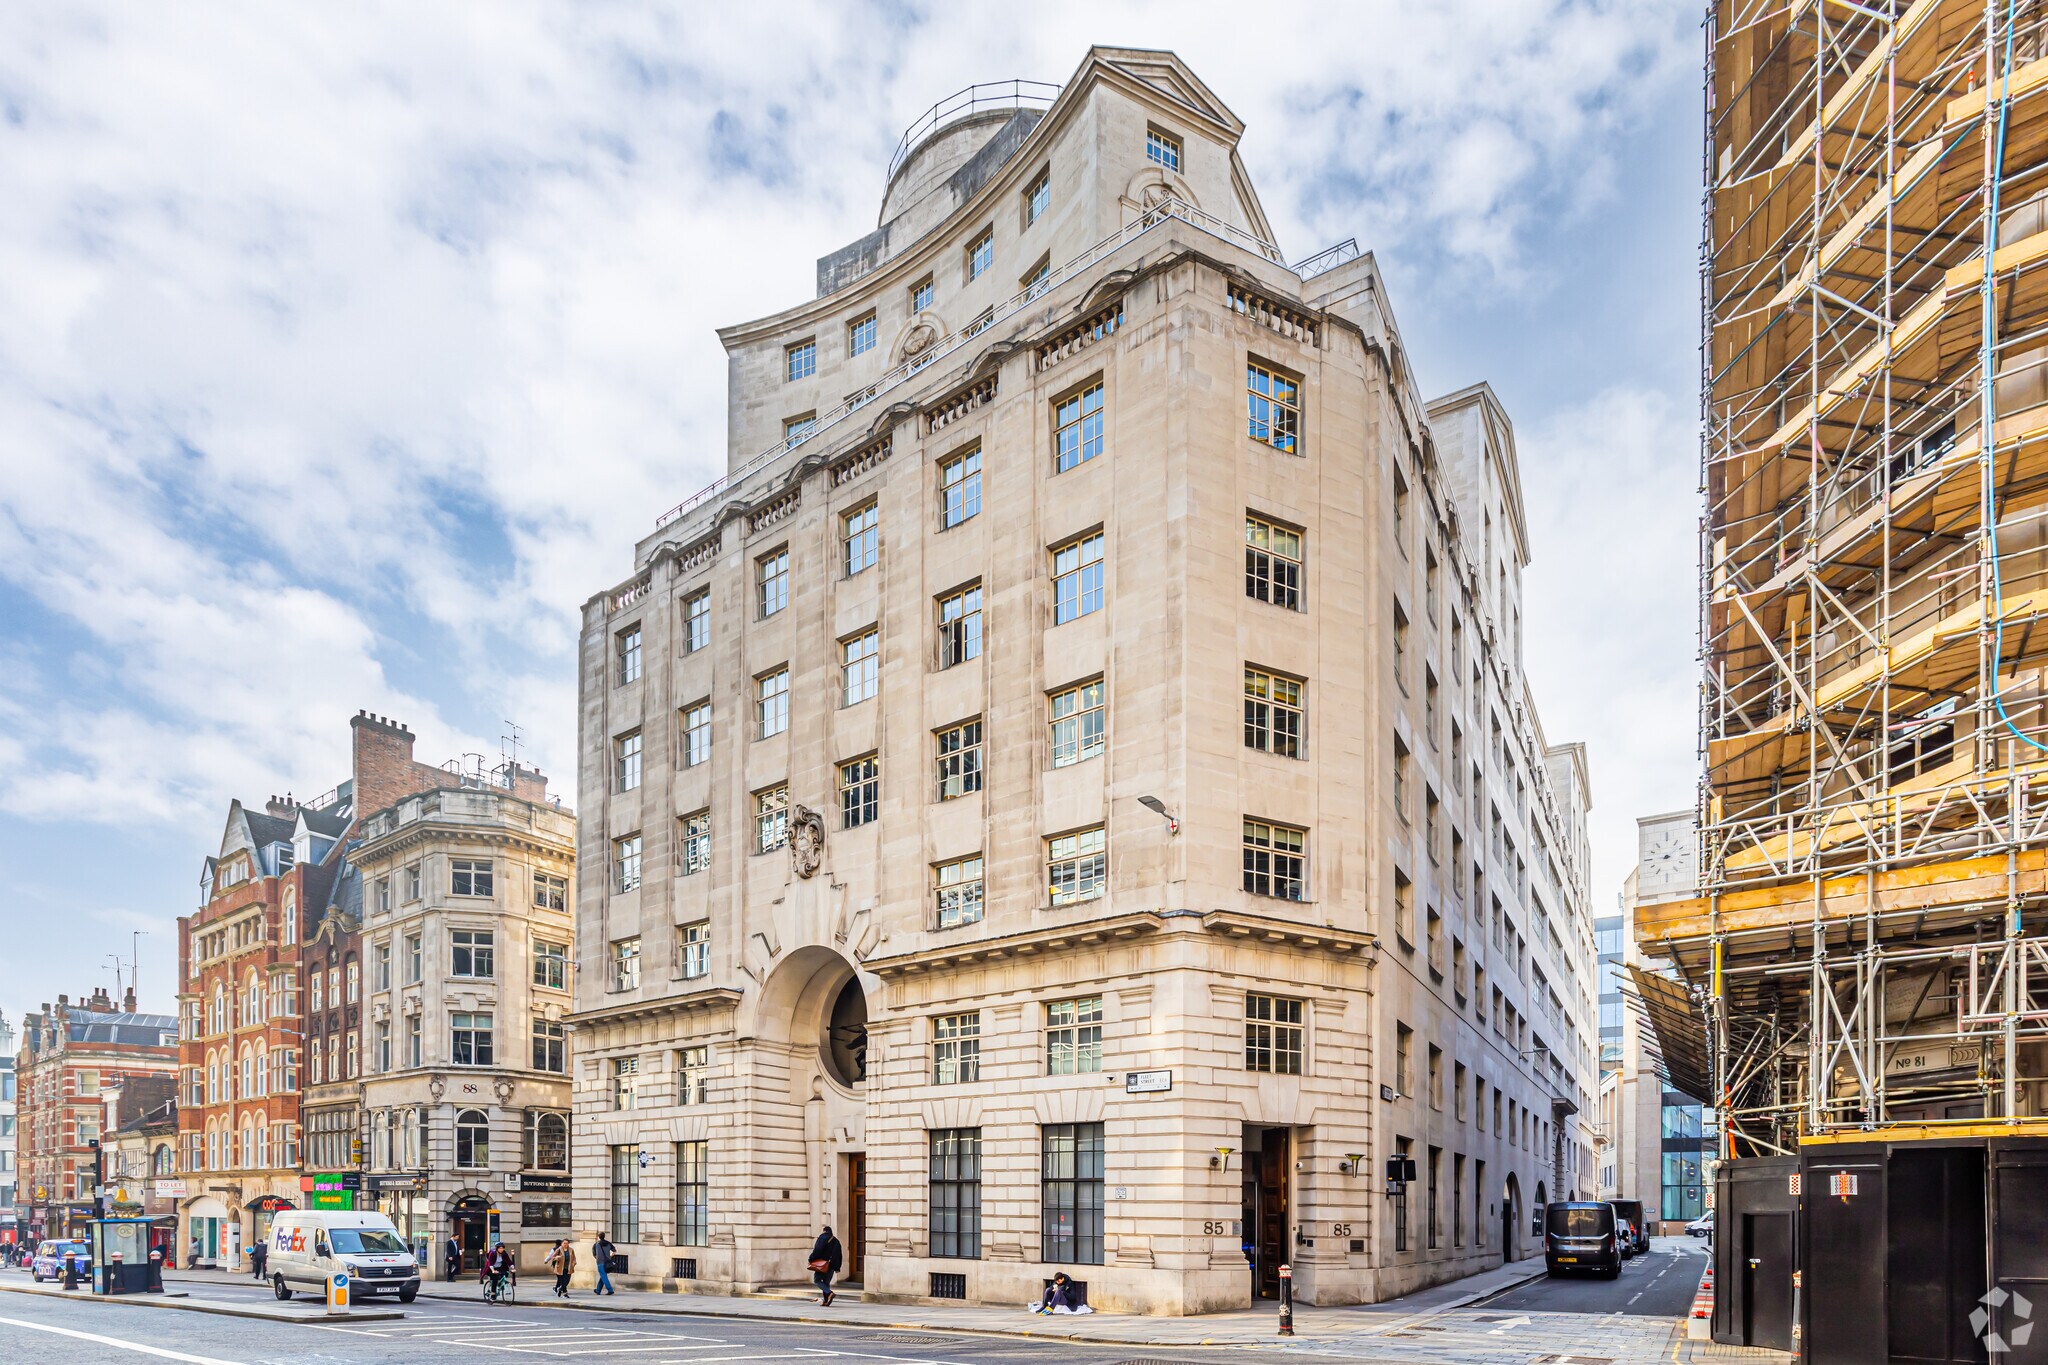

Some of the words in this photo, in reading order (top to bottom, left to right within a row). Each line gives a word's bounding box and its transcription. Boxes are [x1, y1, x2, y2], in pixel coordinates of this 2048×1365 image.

[1914, 1055, 1925, 1067] 81
[463, 1083, 478, 1094] 88
[1203, 1221, 1224, 1235] 85
[1333, 1223, 1351, 1237] 85
[275, 1227, 307, 1252] FedEx
